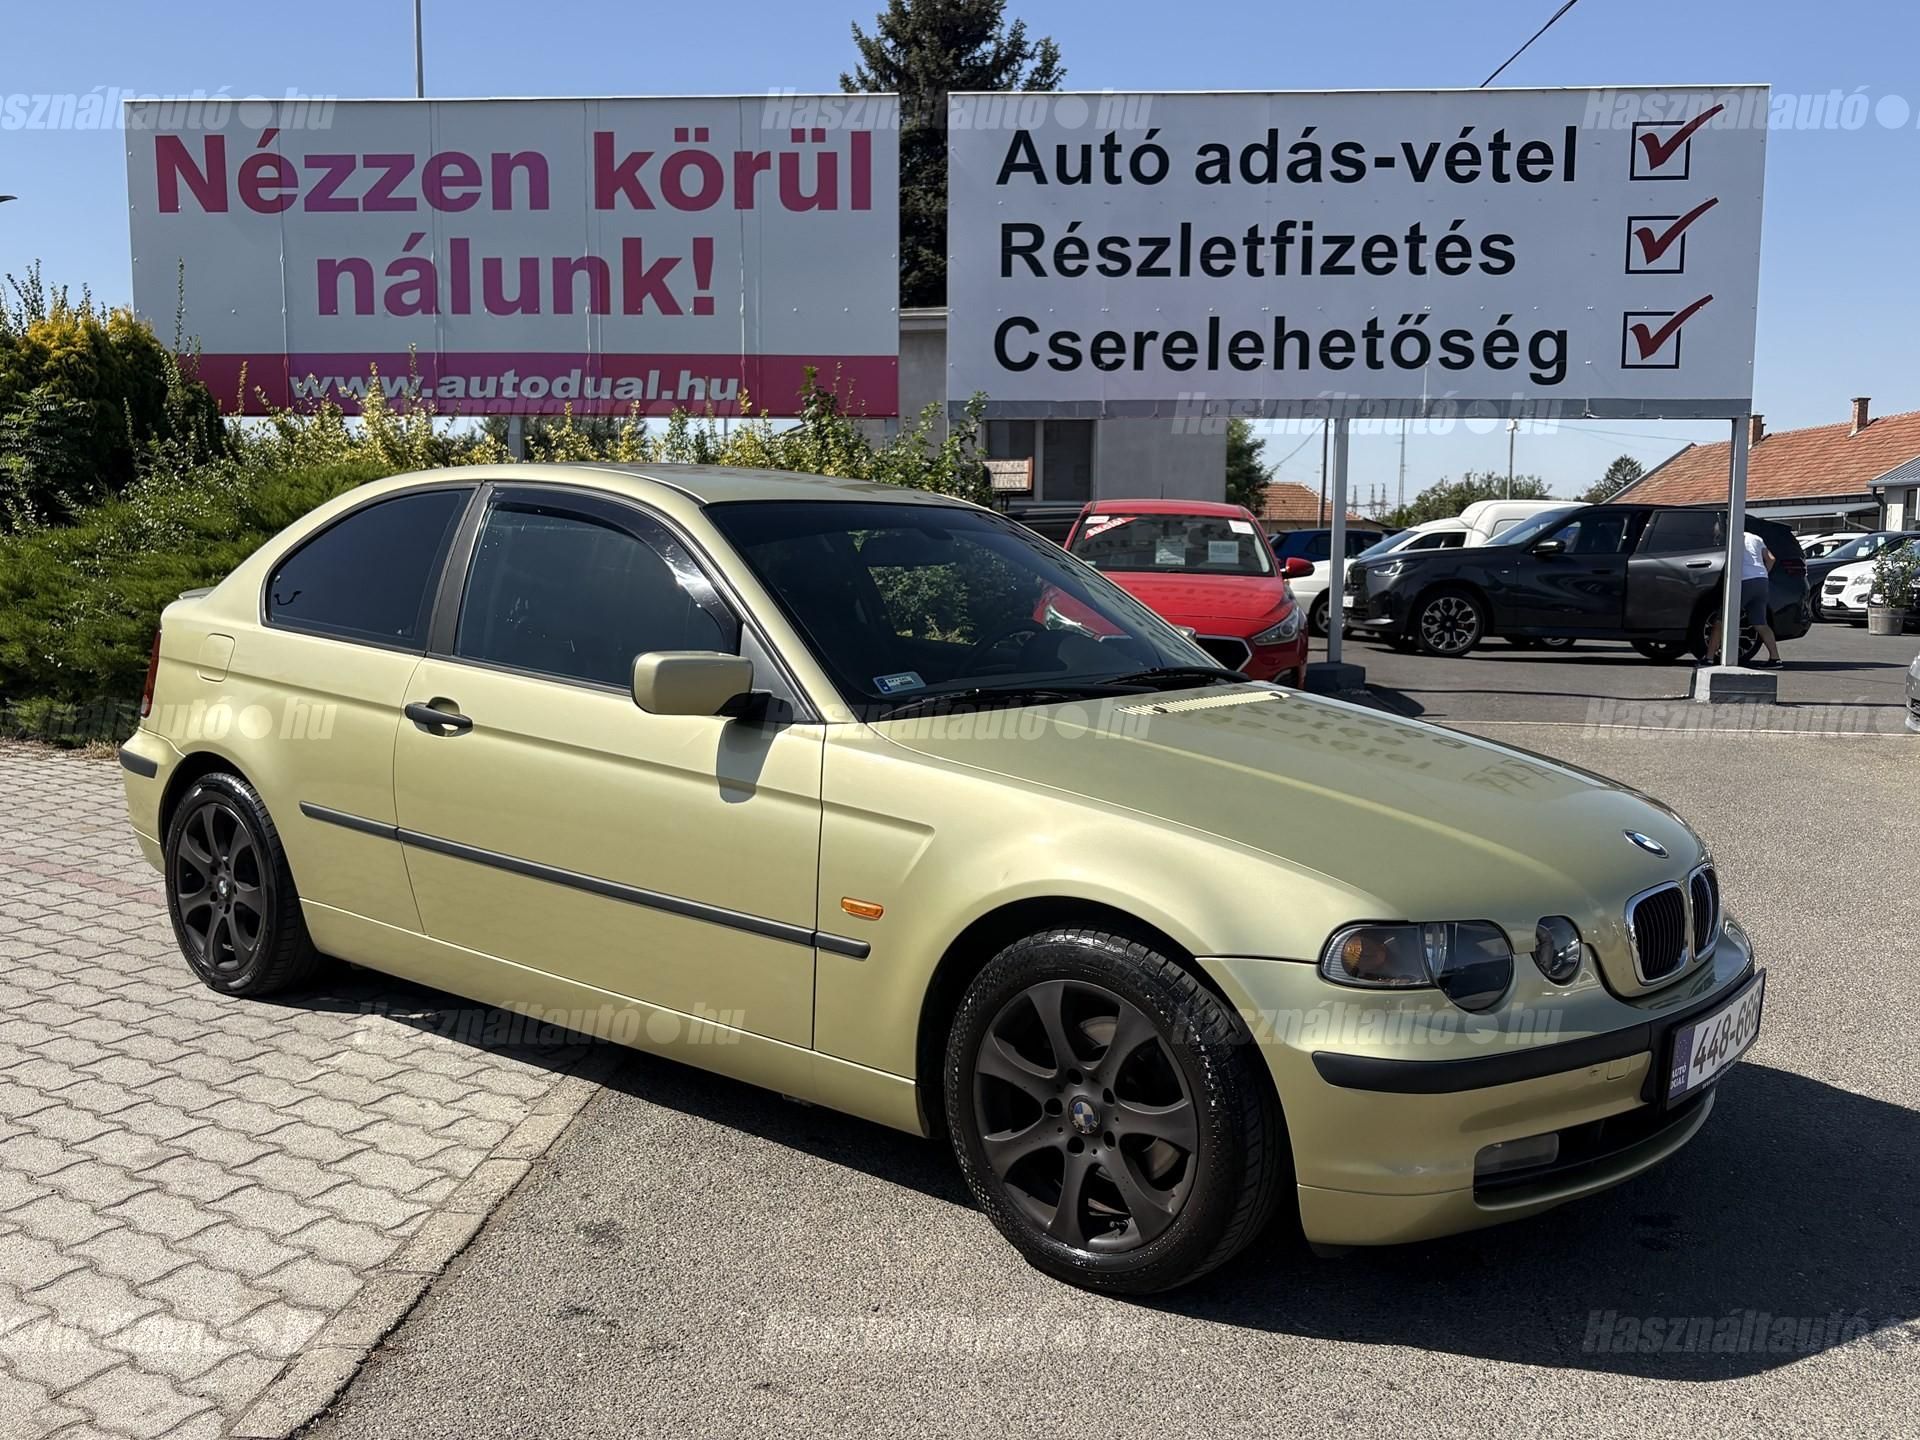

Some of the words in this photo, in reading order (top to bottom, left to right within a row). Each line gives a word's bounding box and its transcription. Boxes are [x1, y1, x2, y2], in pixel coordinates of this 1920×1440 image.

[154, 128, 550, 214] Nézzen
[594, 127, 872, 212] körül
[995, 128, 1170, 186] Autó
[1195, 125, 1577, 184] adás-vétel
[317, 232, 714, 316] nálunk!
[1000, 219, 1517, 278] Részletfizetés
[289, 368, 738, 400] www.autodual.hu
[993, 313, 1568, 386] Cserelehetőség
[1693, 986, 1760, 1075] 448-666
